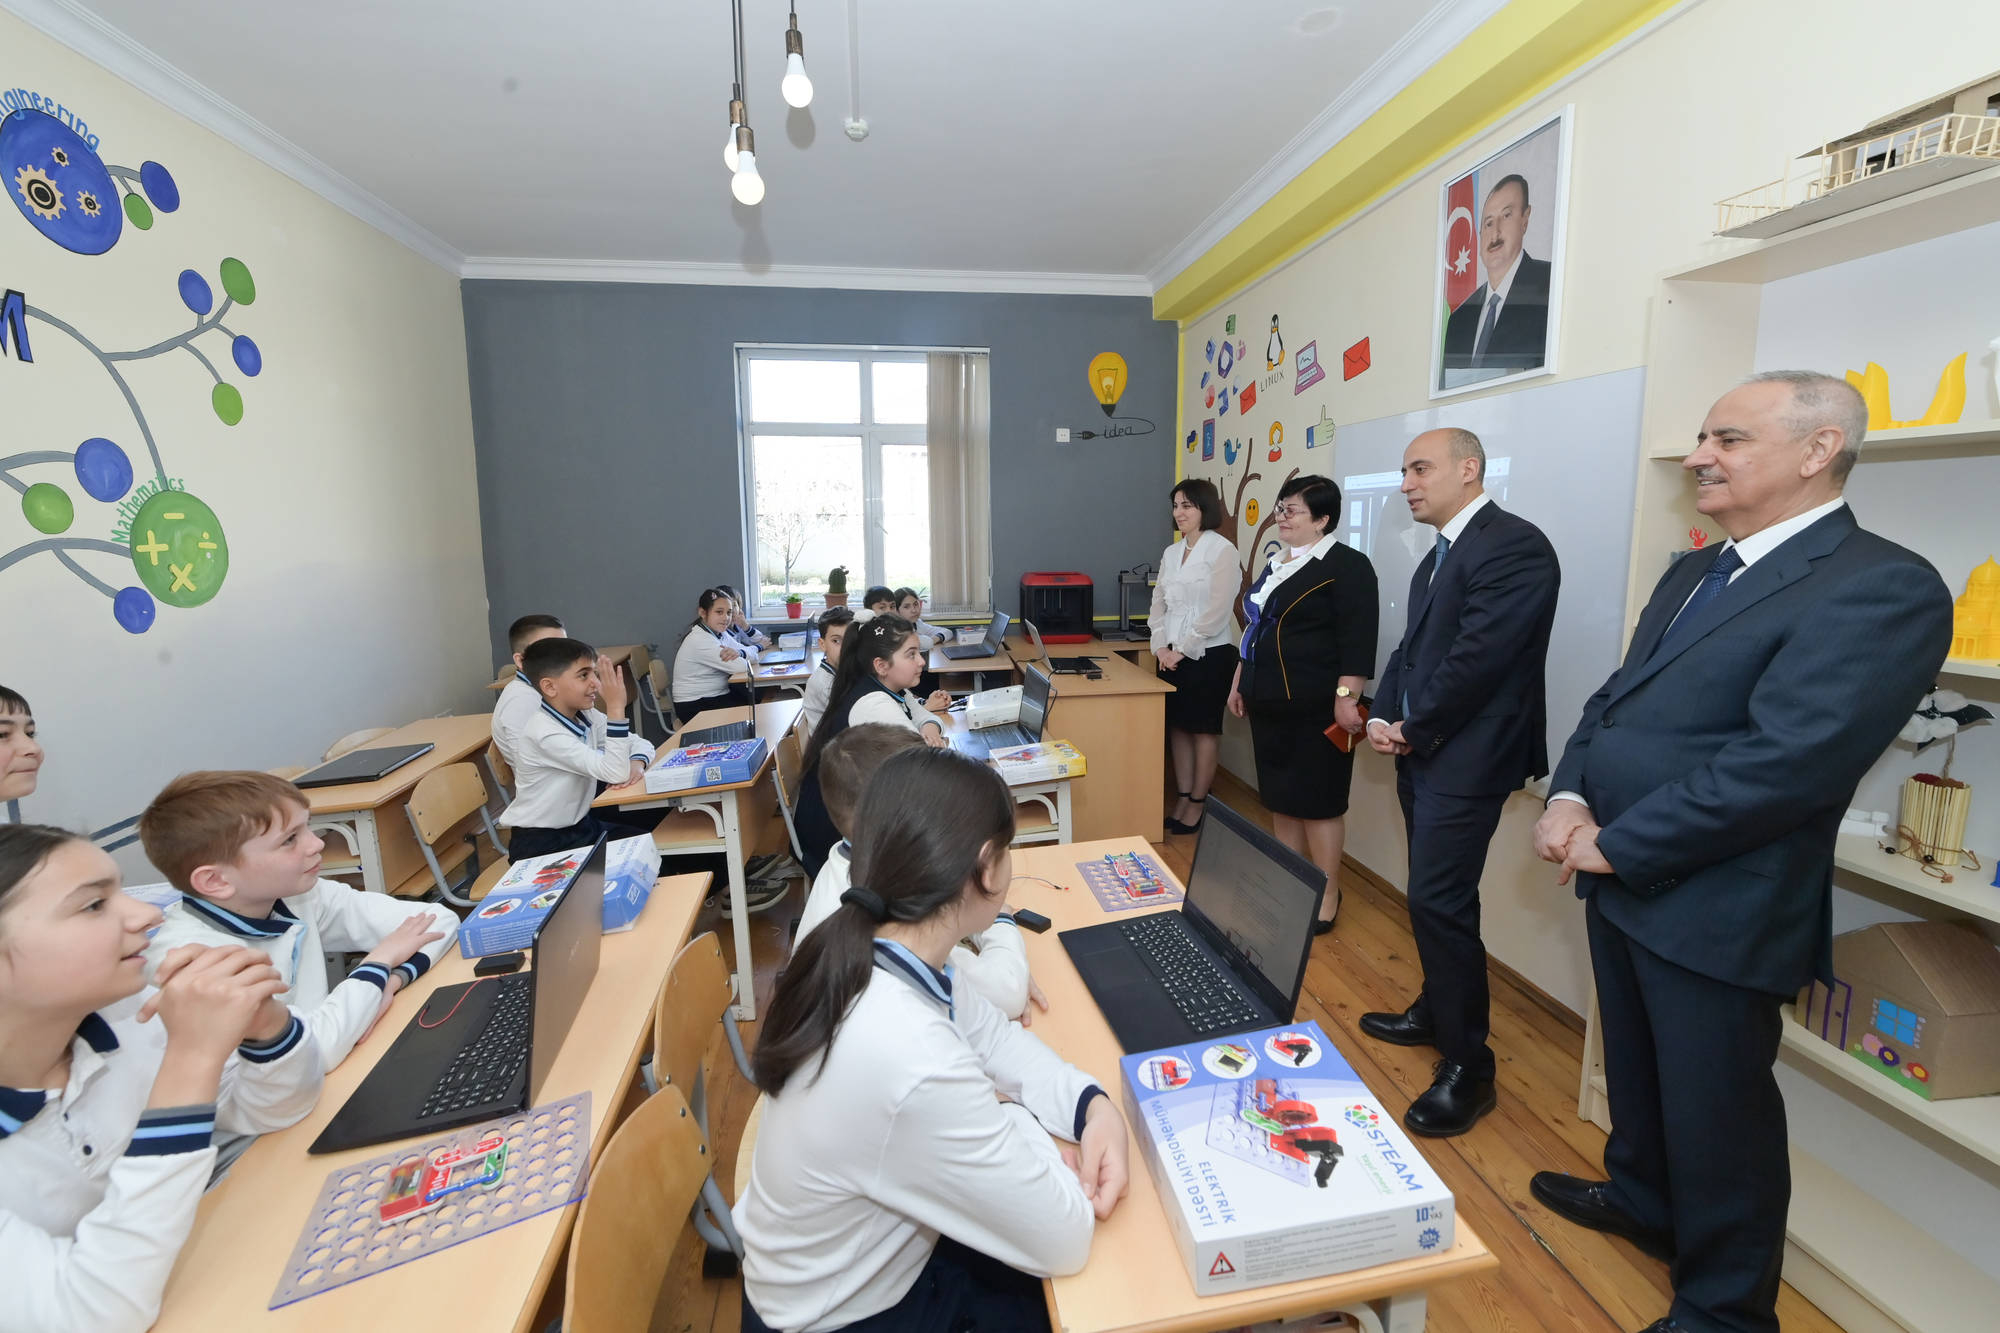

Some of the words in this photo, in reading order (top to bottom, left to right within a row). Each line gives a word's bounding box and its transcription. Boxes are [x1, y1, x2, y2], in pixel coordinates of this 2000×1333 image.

[1260, 369, 1285, 392] LINUX
[1104, 423, 1132, 439] idea
[1367, 1129, 1424, 1191] STEAM
[1187, 1185, 1218, 1227] DƏSTİ
[1199, 1160, 1237, 1223] ELEKTRİK
